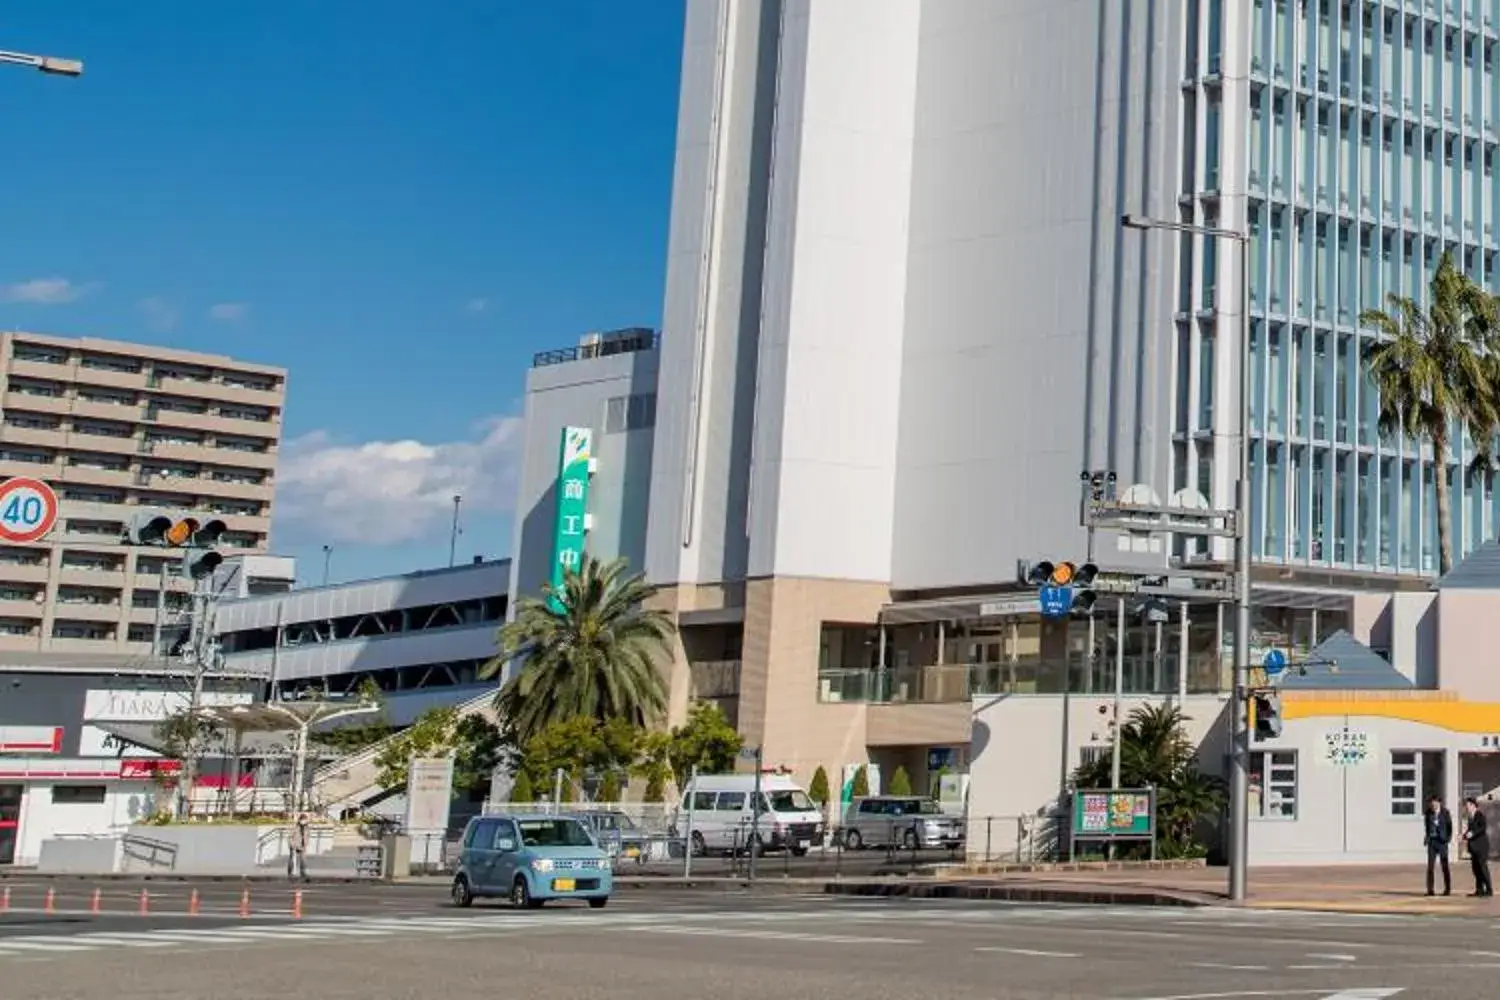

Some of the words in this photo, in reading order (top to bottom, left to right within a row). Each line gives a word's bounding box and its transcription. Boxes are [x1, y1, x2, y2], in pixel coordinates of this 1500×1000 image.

[3, 496, 42, 525] 40
[556, 478, 584, 604] 商工中
[1326, 733, 1367, 741] KOBAN
